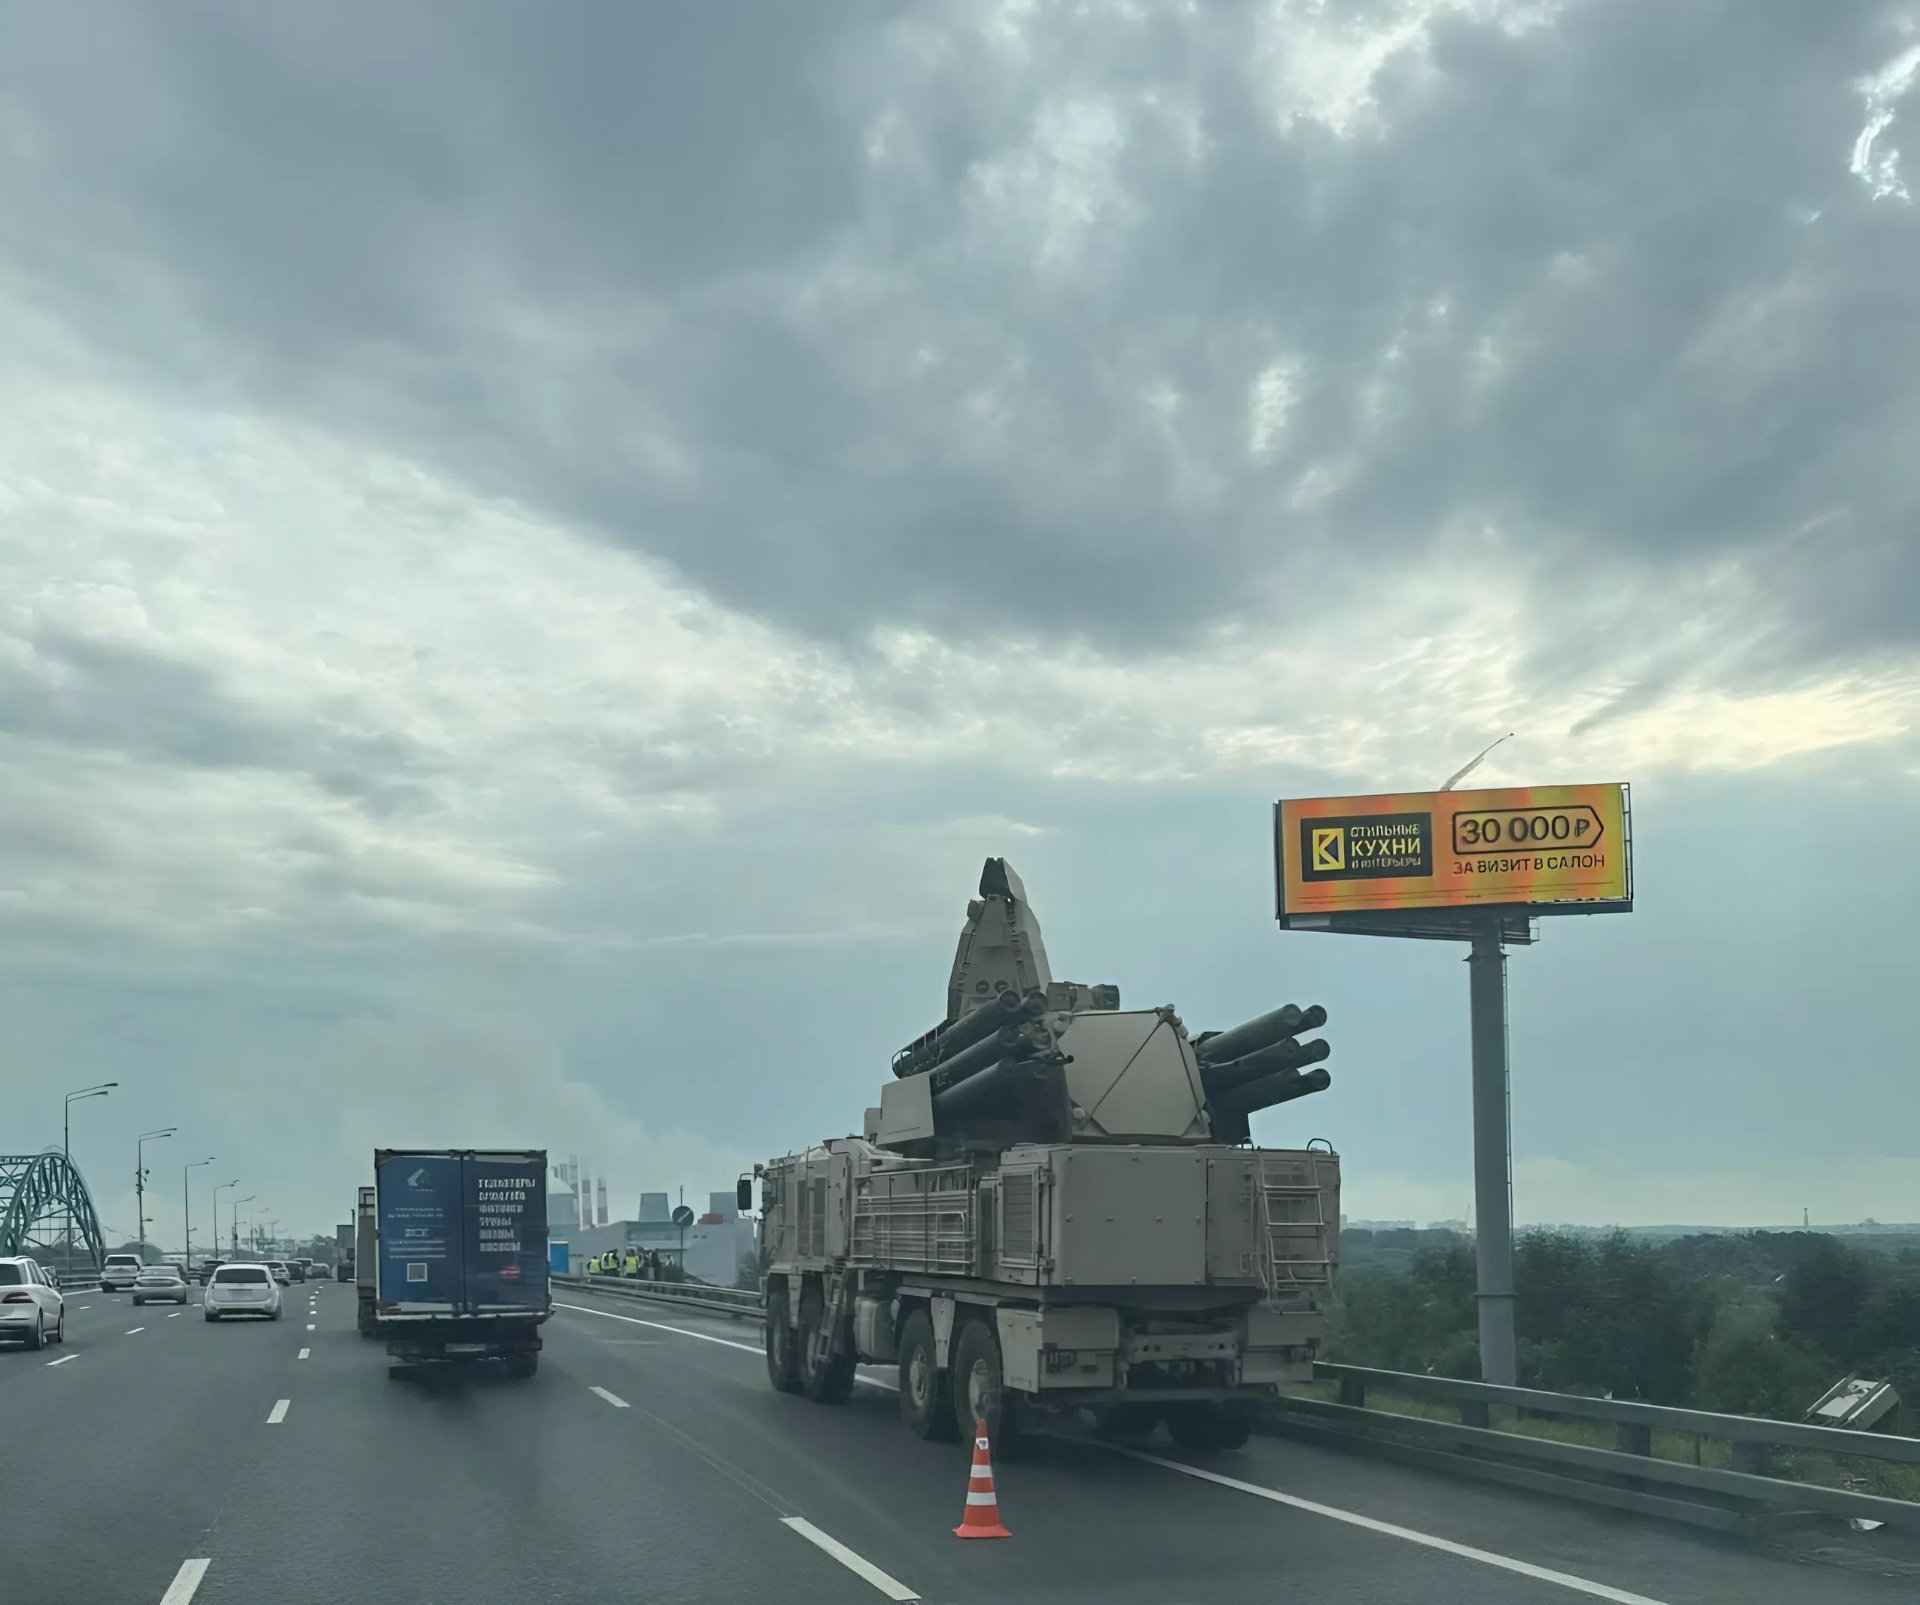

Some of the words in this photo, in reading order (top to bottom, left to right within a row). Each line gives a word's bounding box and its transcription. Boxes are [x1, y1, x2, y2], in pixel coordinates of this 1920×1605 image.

[1460, 818, 1501, 845] 30
[1351, 837, 1421, 857] КУХНИ
[1453, 861, 1474, 875] ЗА
[1477, 857, 1531, 873] ВИЗИТ
[1533, 857, 1544, 870] В
[1547, 854, 1605, 870] САЛОН
